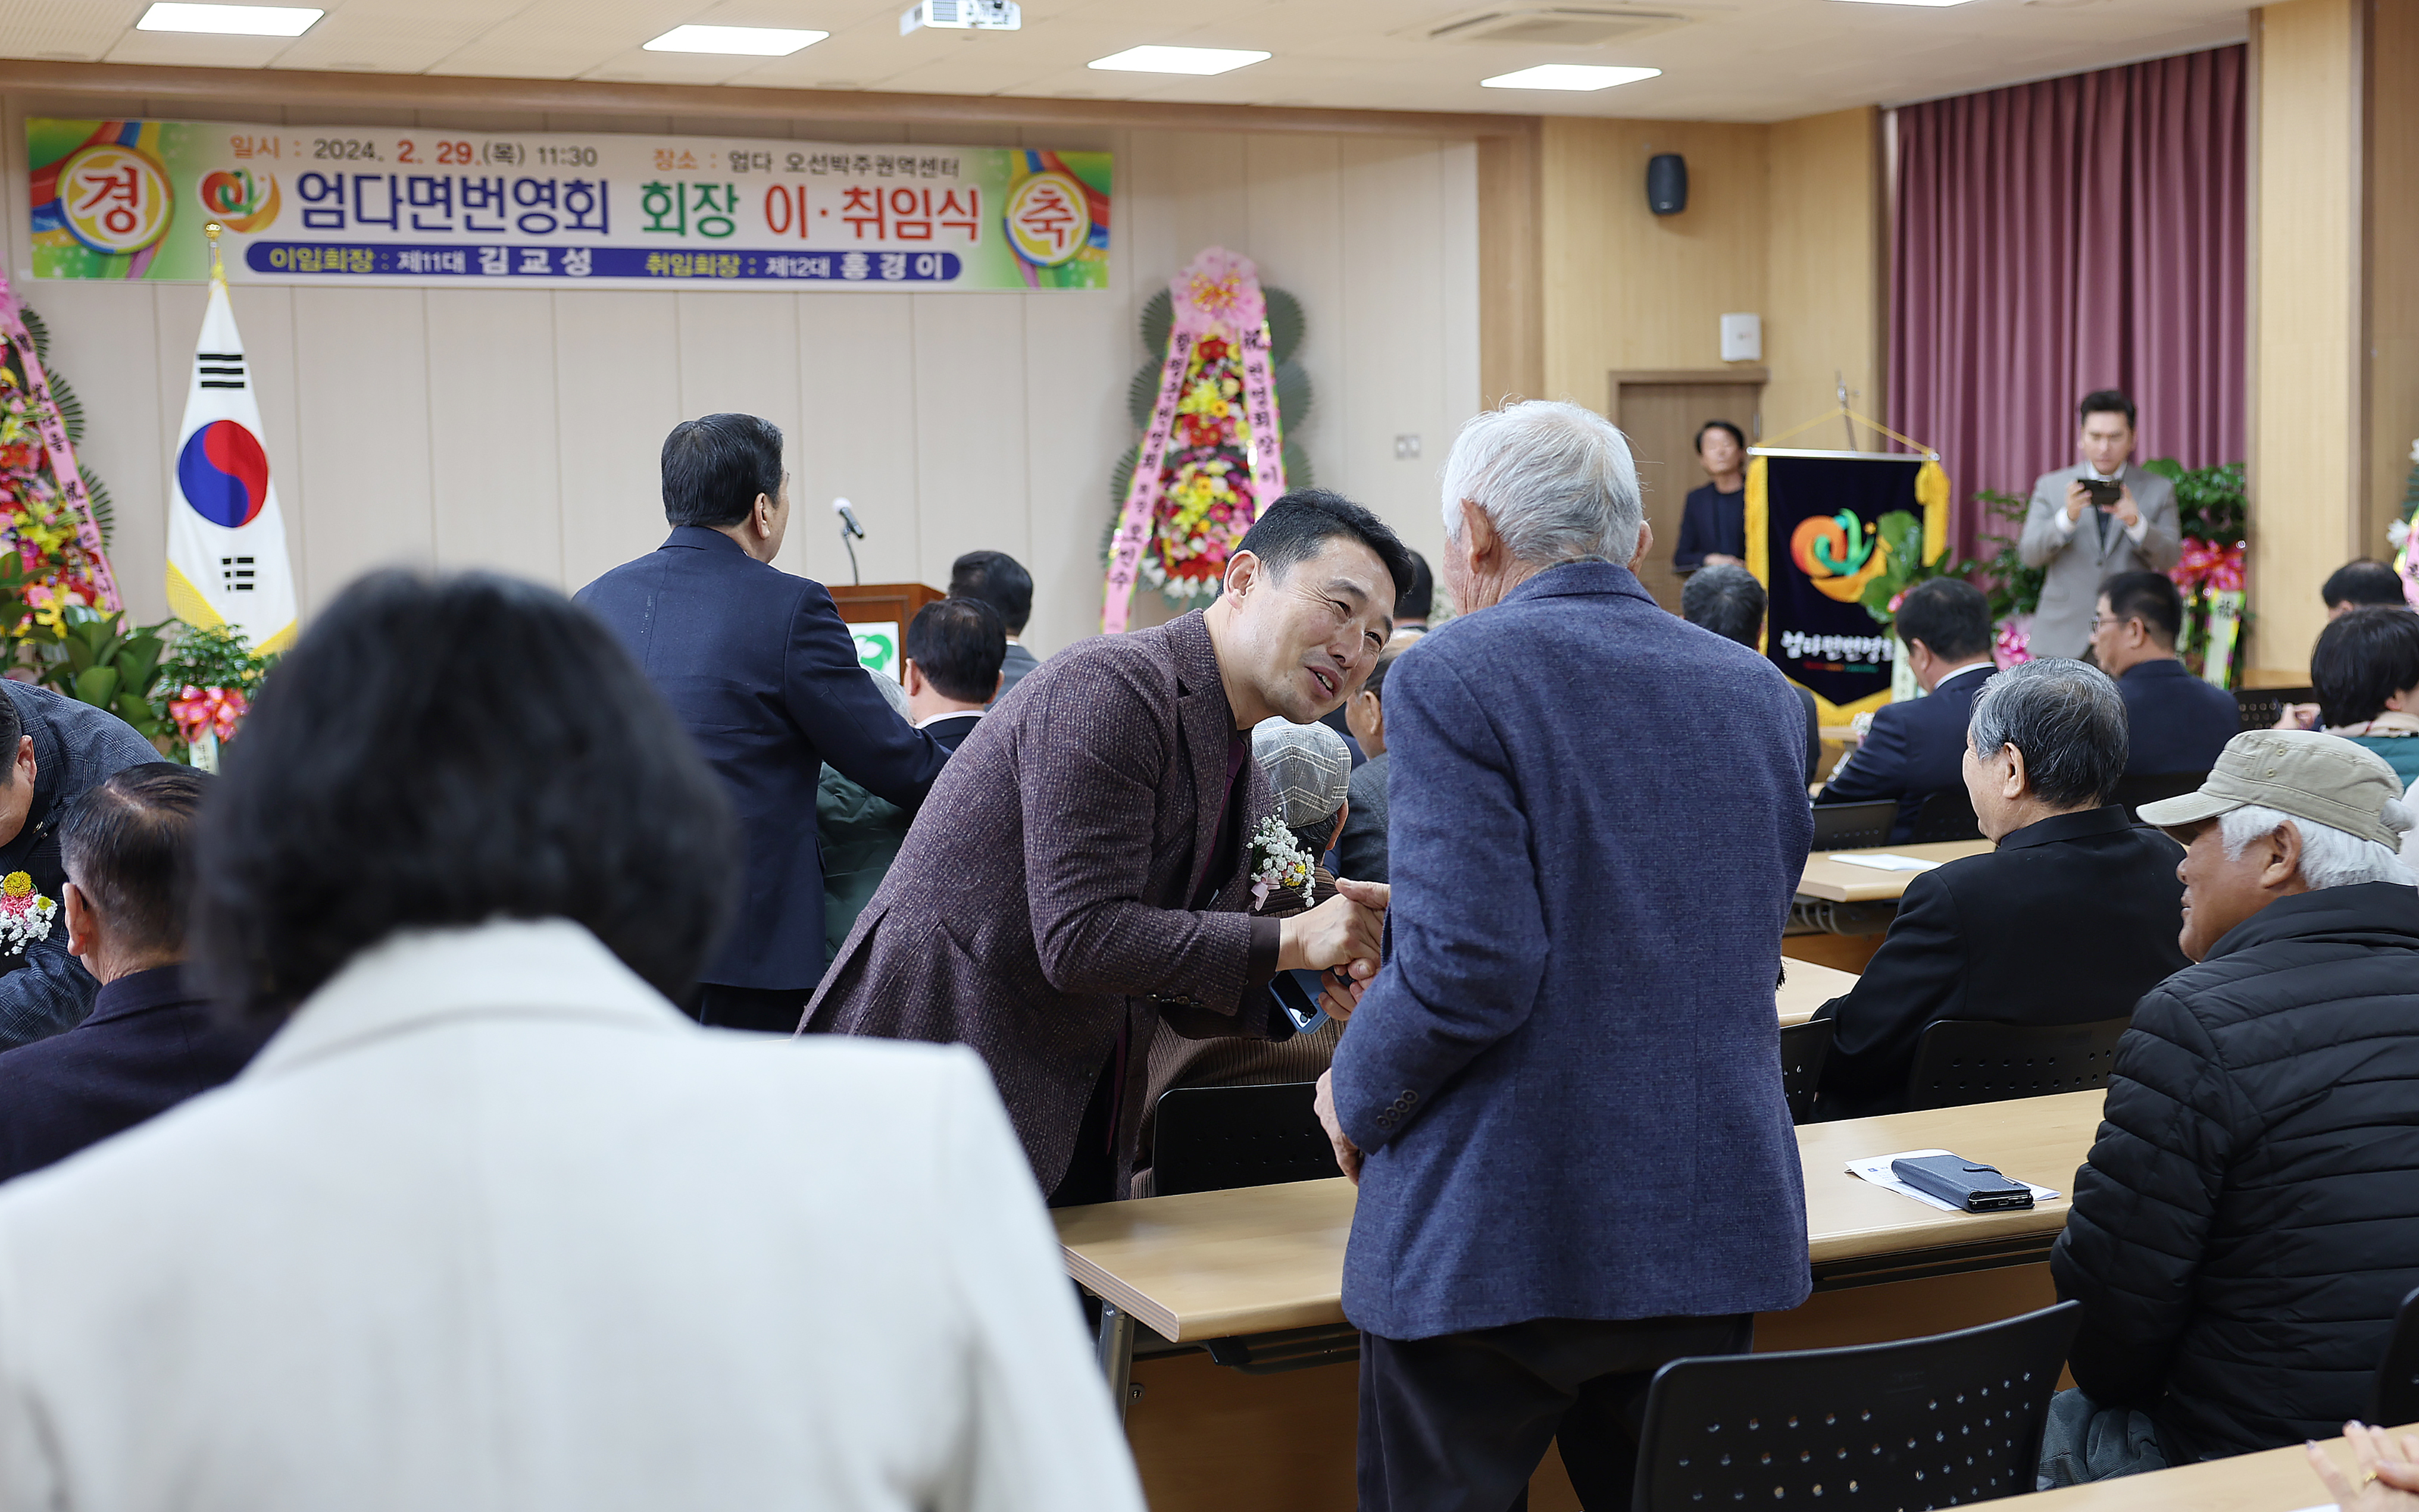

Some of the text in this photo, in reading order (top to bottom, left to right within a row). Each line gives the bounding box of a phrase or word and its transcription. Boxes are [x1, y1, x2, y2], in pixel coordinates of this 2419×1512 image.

[230, 136, 279, 159] 일시
[313, 138, 384, 161] 2024.
[537, 146, 598, 167] 11:30
[654, 148, 699, 171] 장소
[729, 149, 772, 173] 엄다
[79, 164, 139, 233] 경
[298, 172, 610, 235] 엄다면번영회
[641, 180, 739, 238] 회장
[1021, 189, 1074, 249] 축
[270, 248, 374, 273] 이임회장
[397, 249, 466, 274] 제11대
[646, 252, 741, 278] 취임회장
[765, 255, 832, 278] 제12대
